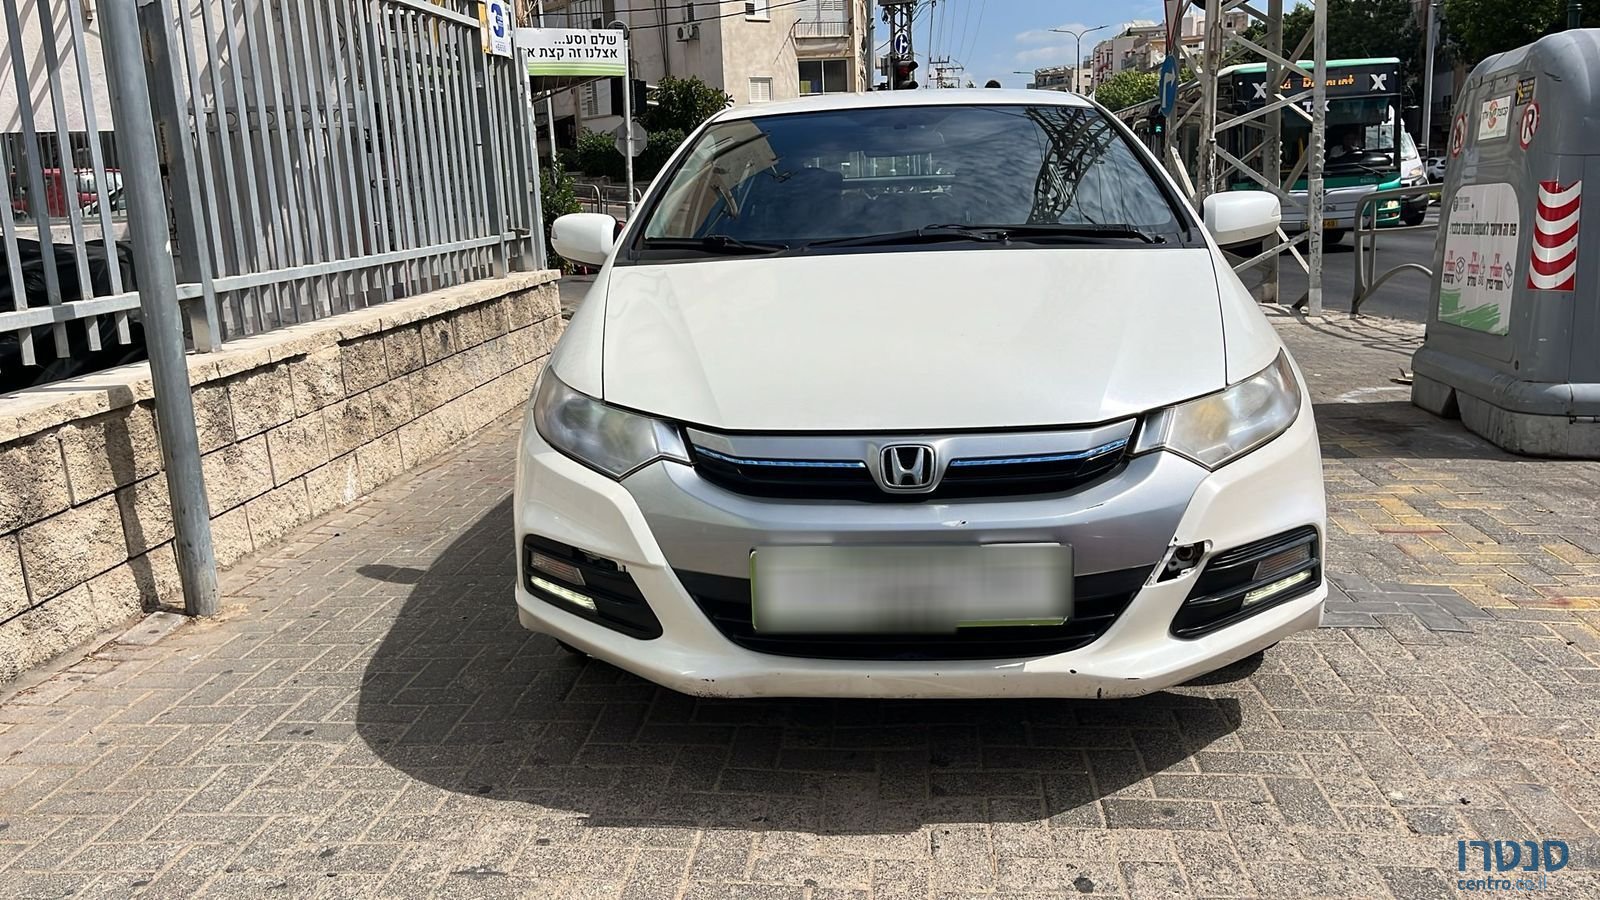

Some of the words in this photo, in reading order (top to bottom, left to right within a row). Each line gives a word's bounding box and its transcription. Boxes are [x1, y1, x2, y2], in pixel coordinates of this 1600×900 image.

[554, 34, 587, 45] וסע...
[590, 34, 617, 45] שלם
[540, 47, 565, 60] קצת
[568, 47, 581, 58] זה
[586, 47, 618, 58] אצלנו
